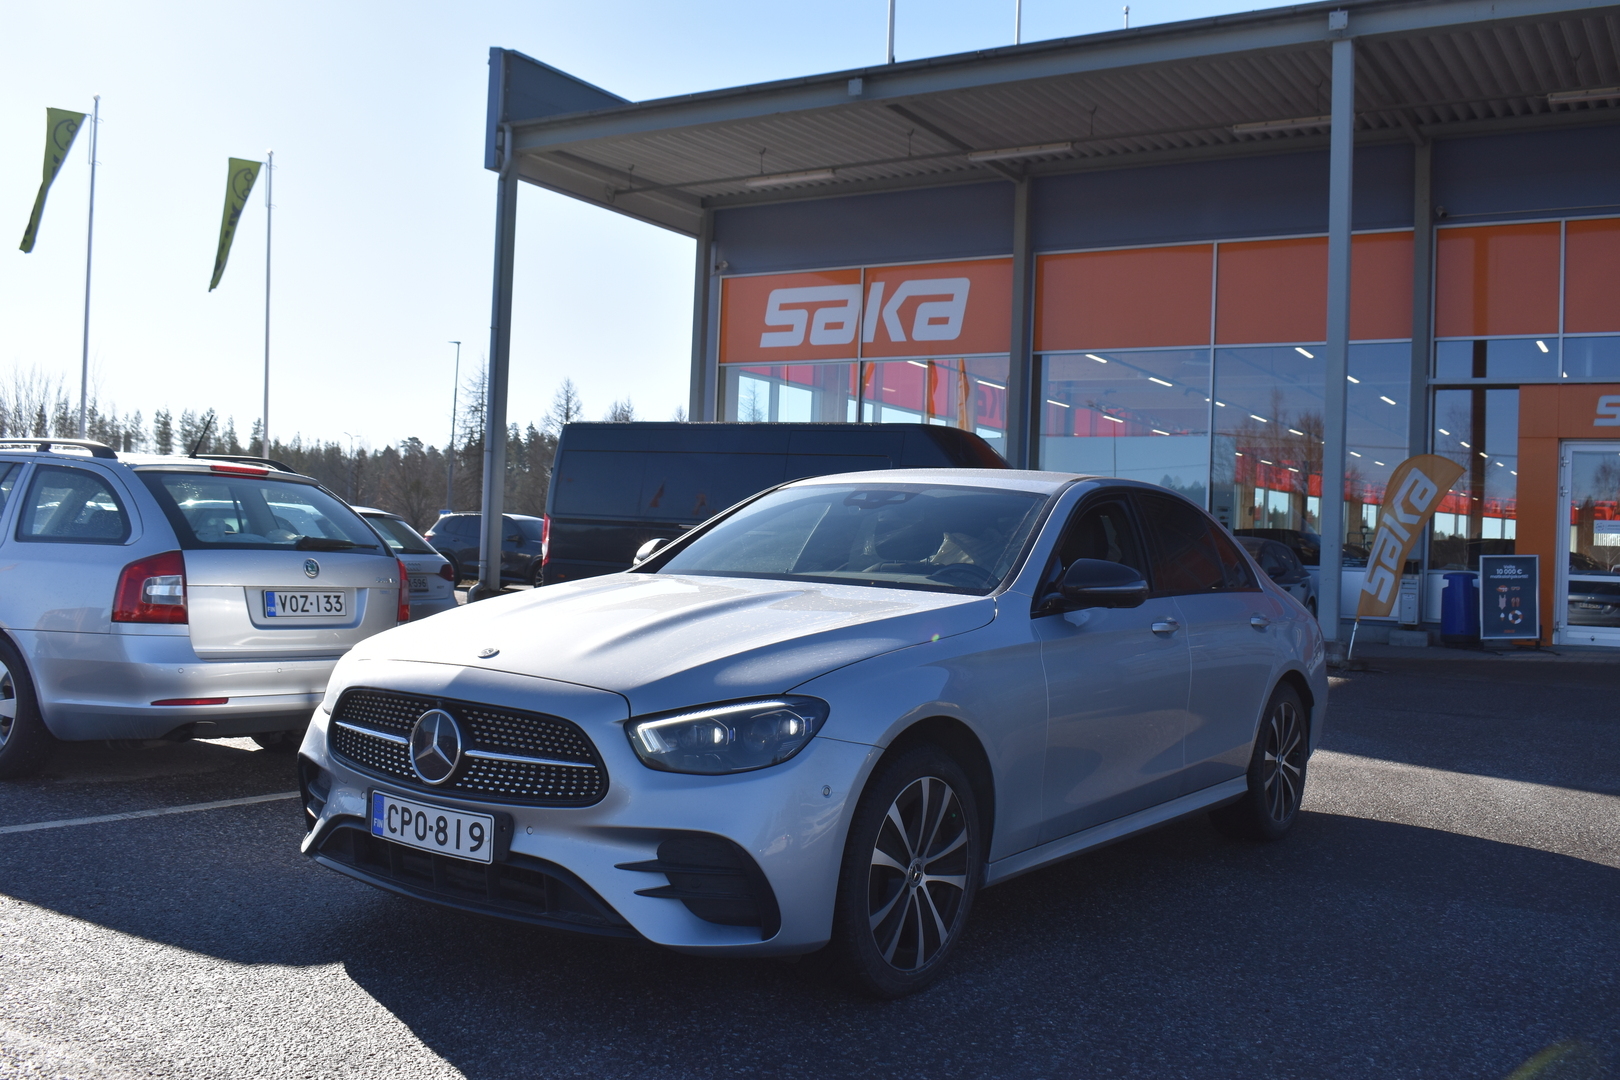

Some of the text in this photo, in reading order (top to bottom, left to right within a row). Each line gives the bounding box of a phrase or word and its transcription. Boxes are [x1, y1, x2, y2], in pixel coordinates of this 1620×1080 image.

[278, 594, 343, 613] VOZ-133
[373, 803, 485, 853] FIN CPO-819
